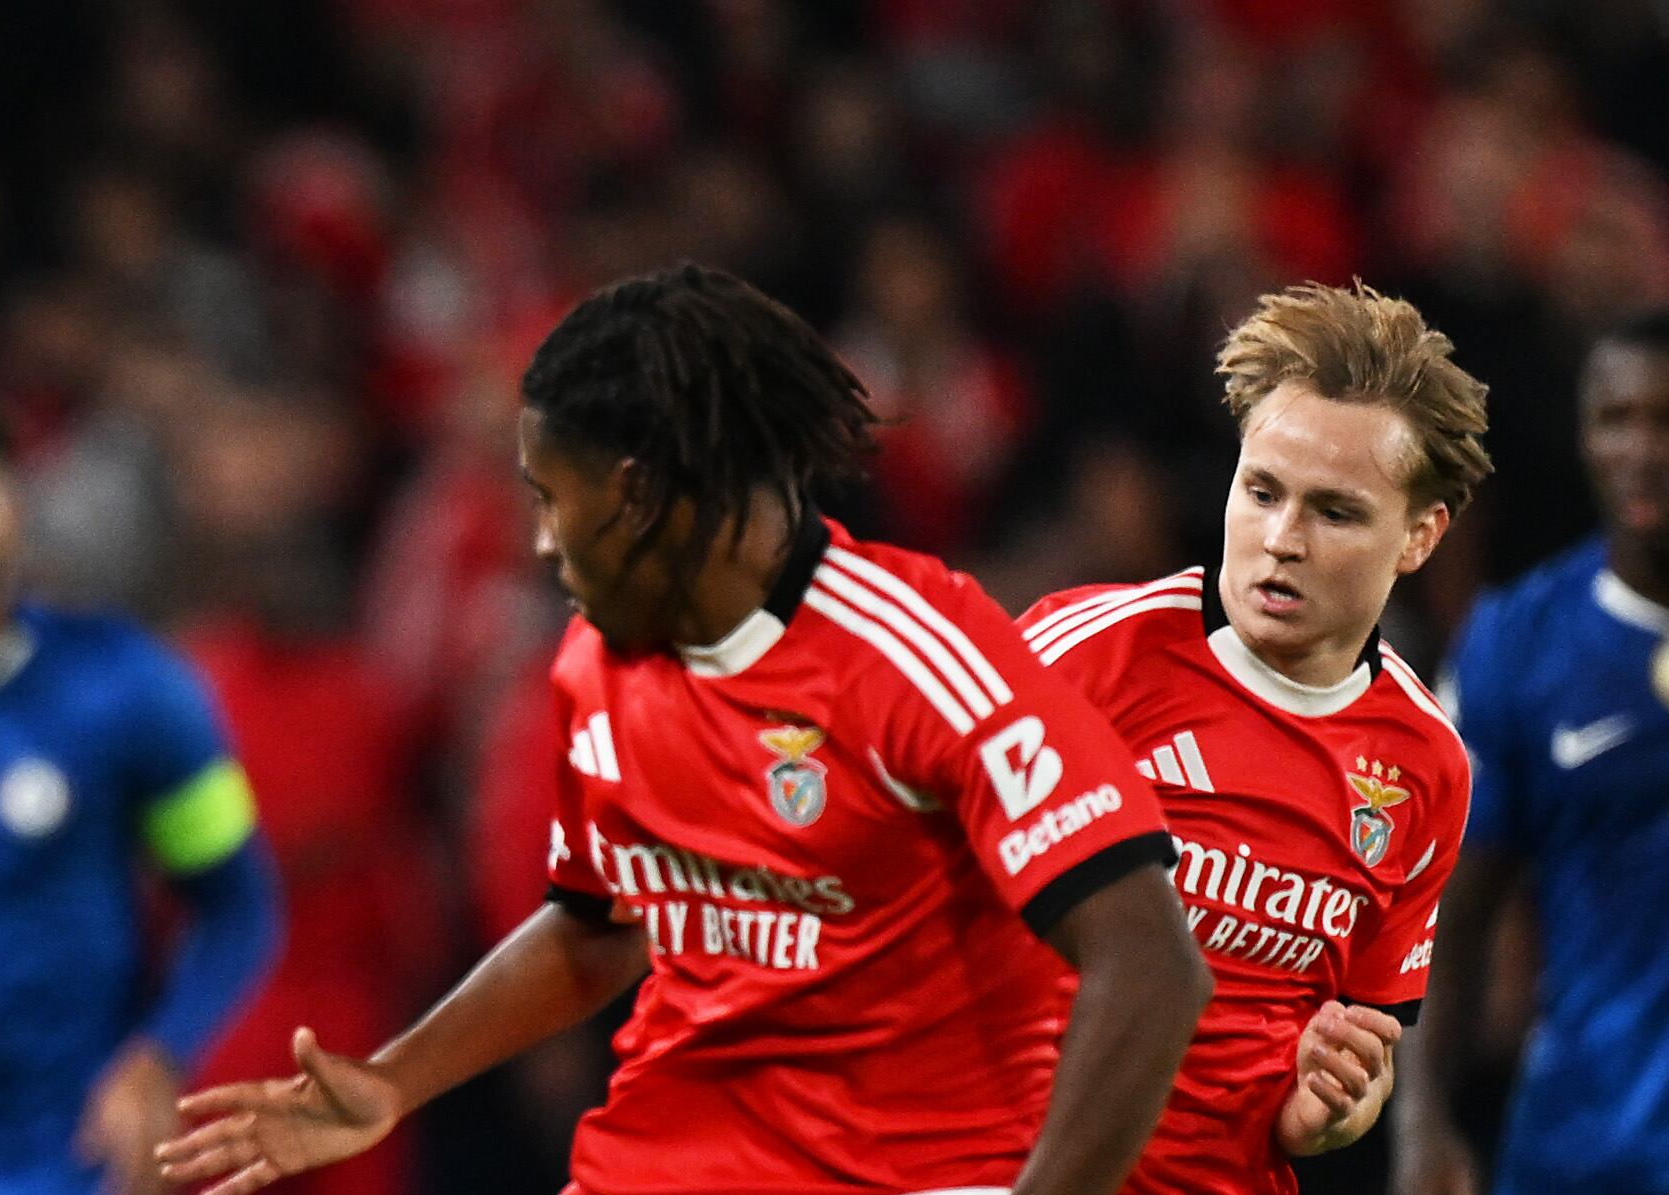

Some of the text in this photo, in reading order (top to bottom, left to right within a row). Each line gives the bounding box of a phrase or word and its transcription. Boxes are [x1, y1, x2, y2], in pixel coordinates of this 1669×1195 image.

[998, 783, 1123, 876] Betano
[631, 901, 821, 970] LY BETTER
[1206, 914, 1326, 973] BETTER
